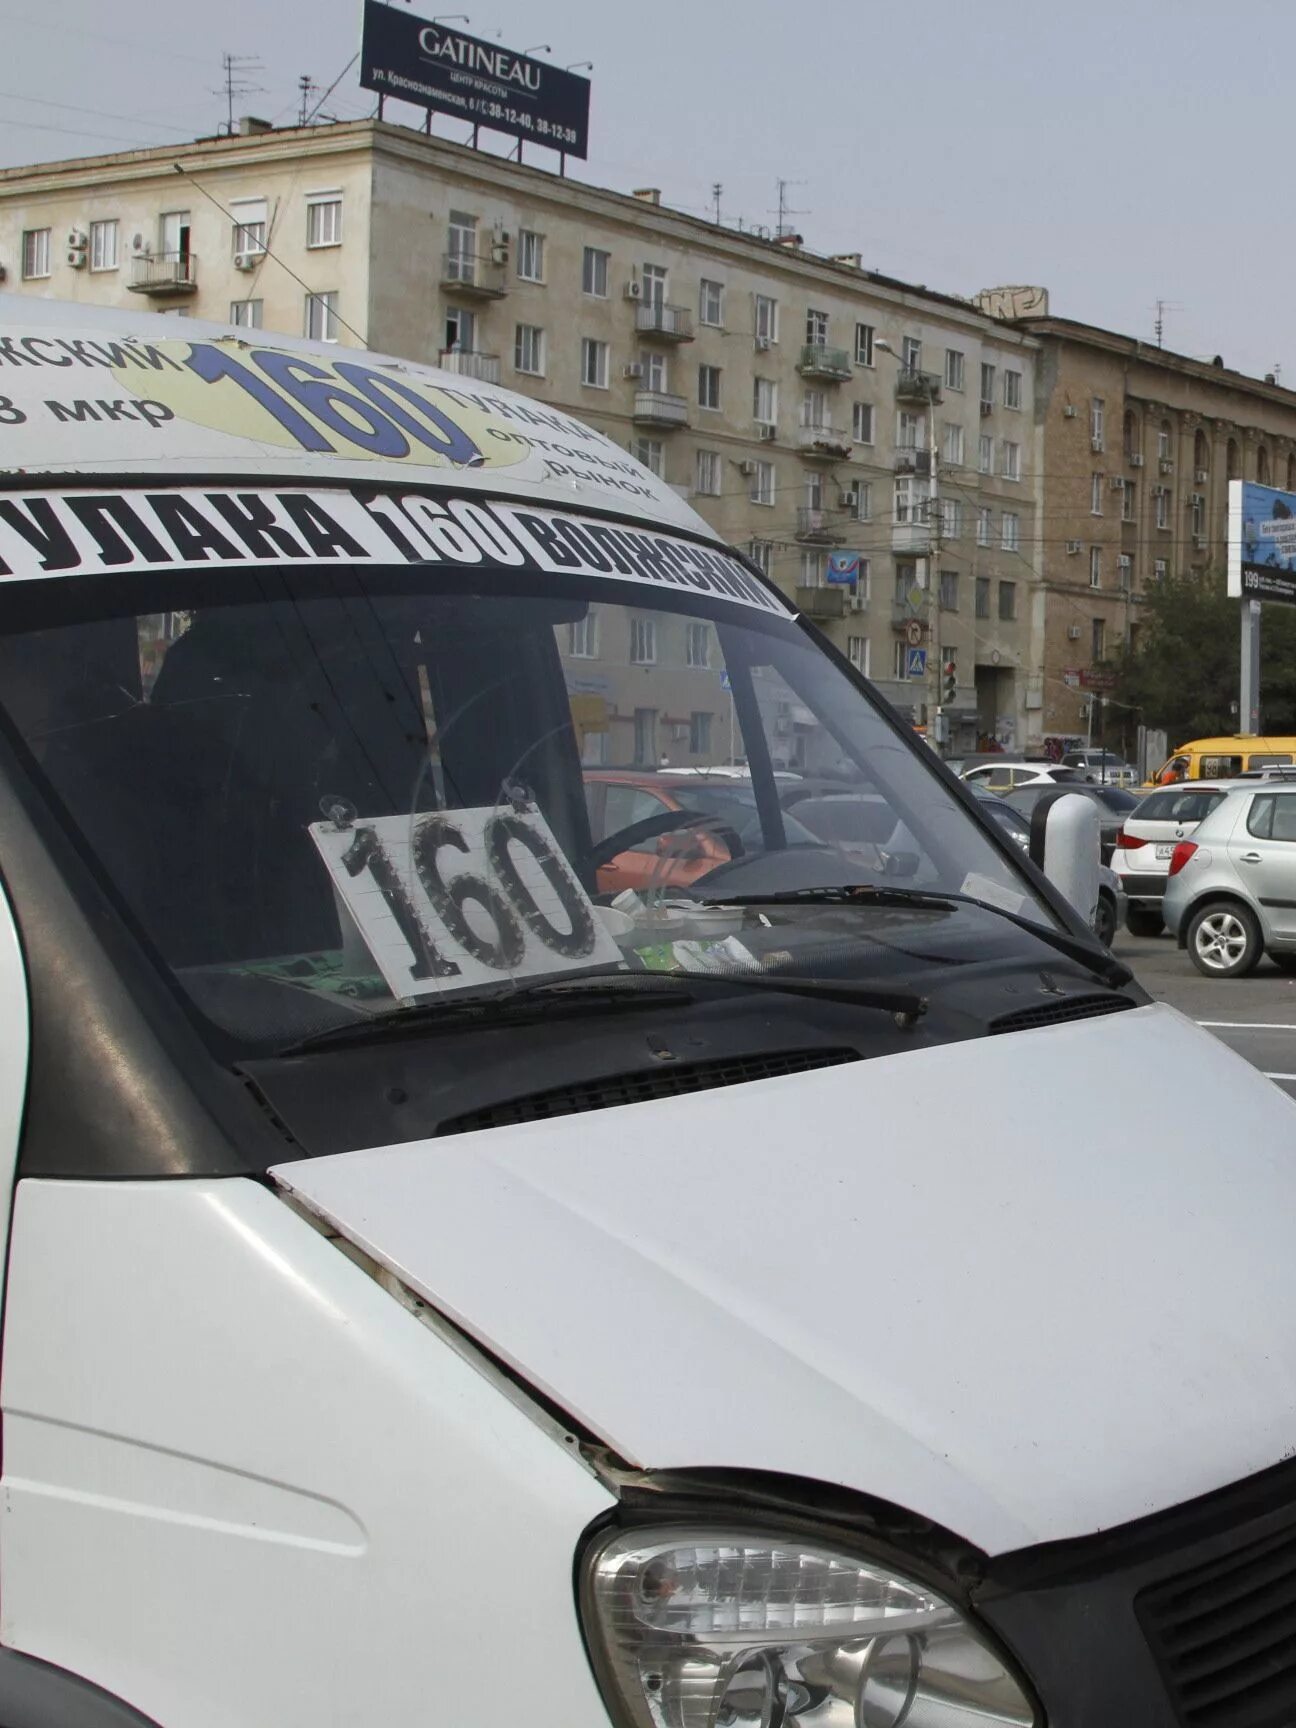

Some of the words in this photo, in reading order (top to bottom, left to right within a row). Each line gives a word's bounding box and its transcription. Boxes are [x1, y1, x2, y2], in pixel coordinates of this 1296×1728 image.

[418, 27, 541, 91] GATINEAU
[450, 72, 474, 88] ЦЕНТР
[474, 79, 508, 98] КРАСОТЫ
[182, 342, 485, 468] 160
[425, 383, 610, 448] ТУЛАКА
[0, 493, 373, 576] УЛАКА
[365, 493, 525, 567] 160
[340, 813, 596, 981] 160
